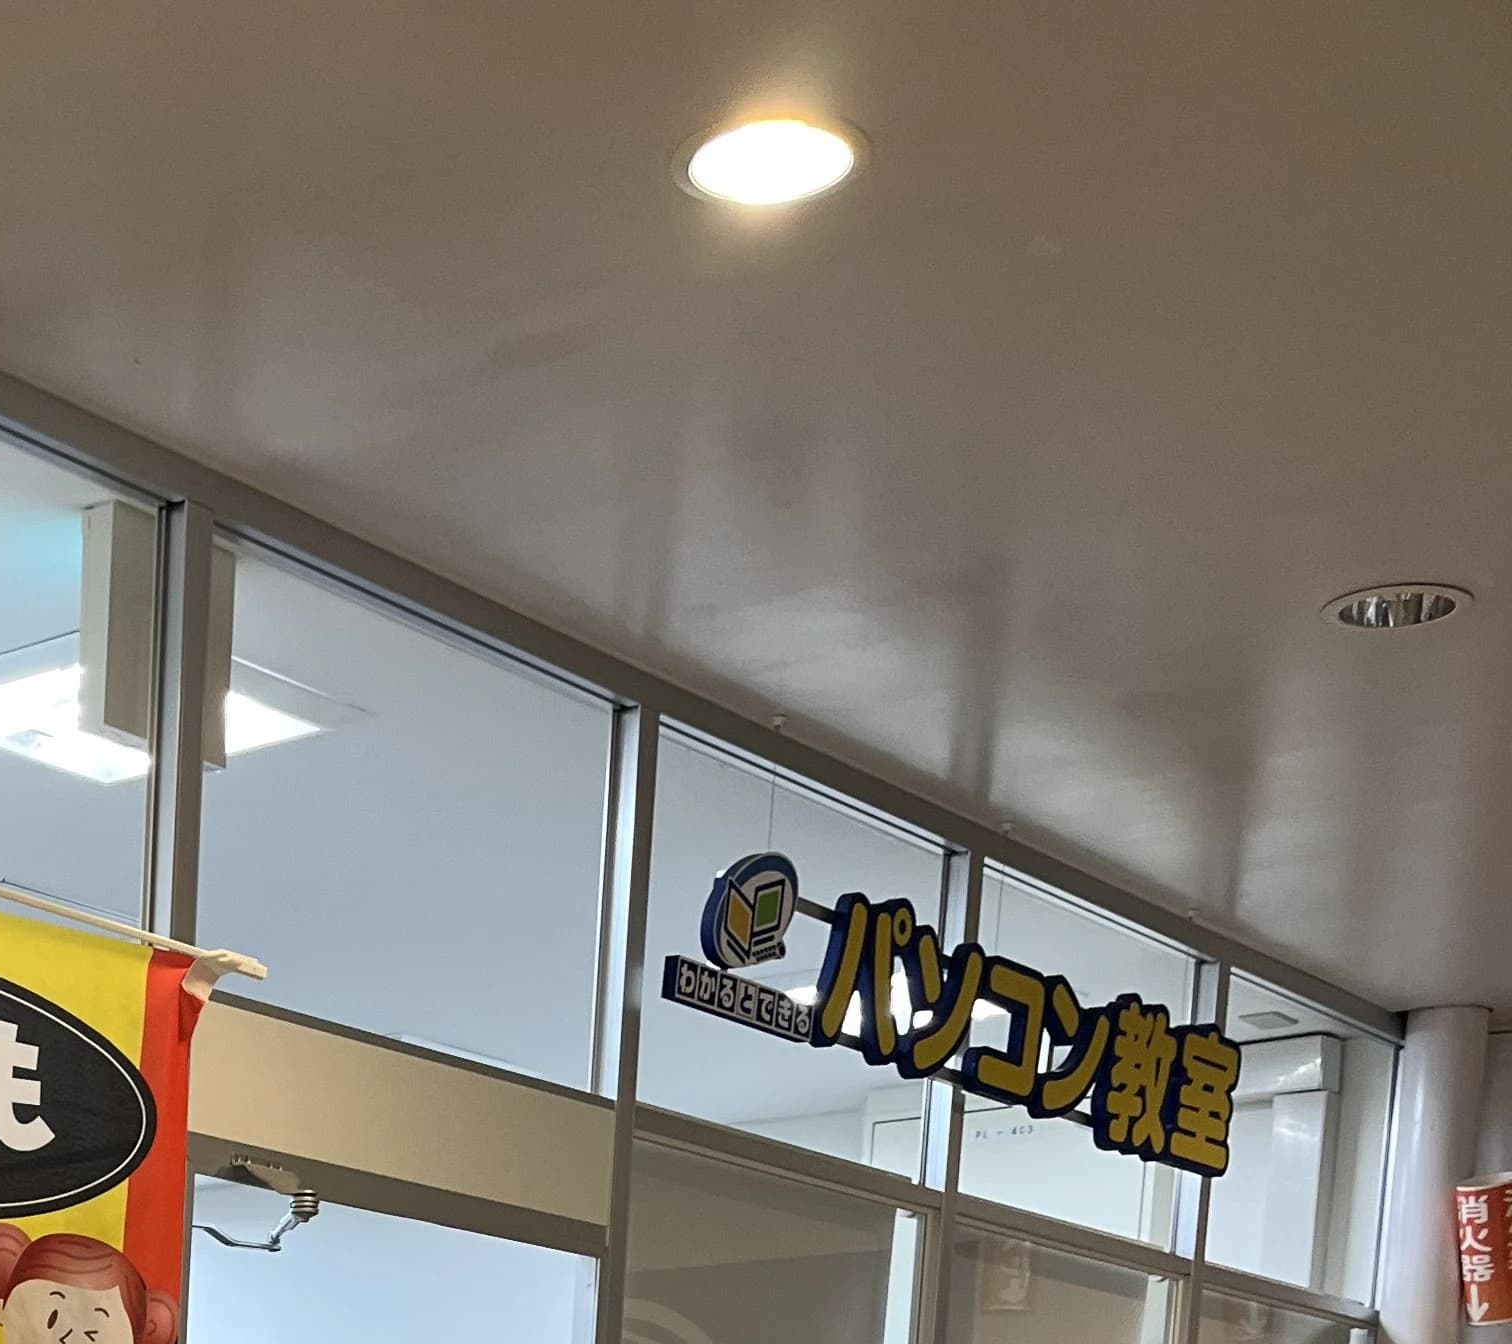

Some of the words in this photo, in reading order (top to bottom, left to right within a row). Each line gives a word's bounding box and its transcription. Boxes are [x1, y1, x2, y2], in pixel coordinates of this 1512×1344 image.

[678, 960, 812, 1036] わかるとできる
[818, 896, 1241, 1174] パソコン教室
[1456, 1195, 1495, 1282] 消火器
